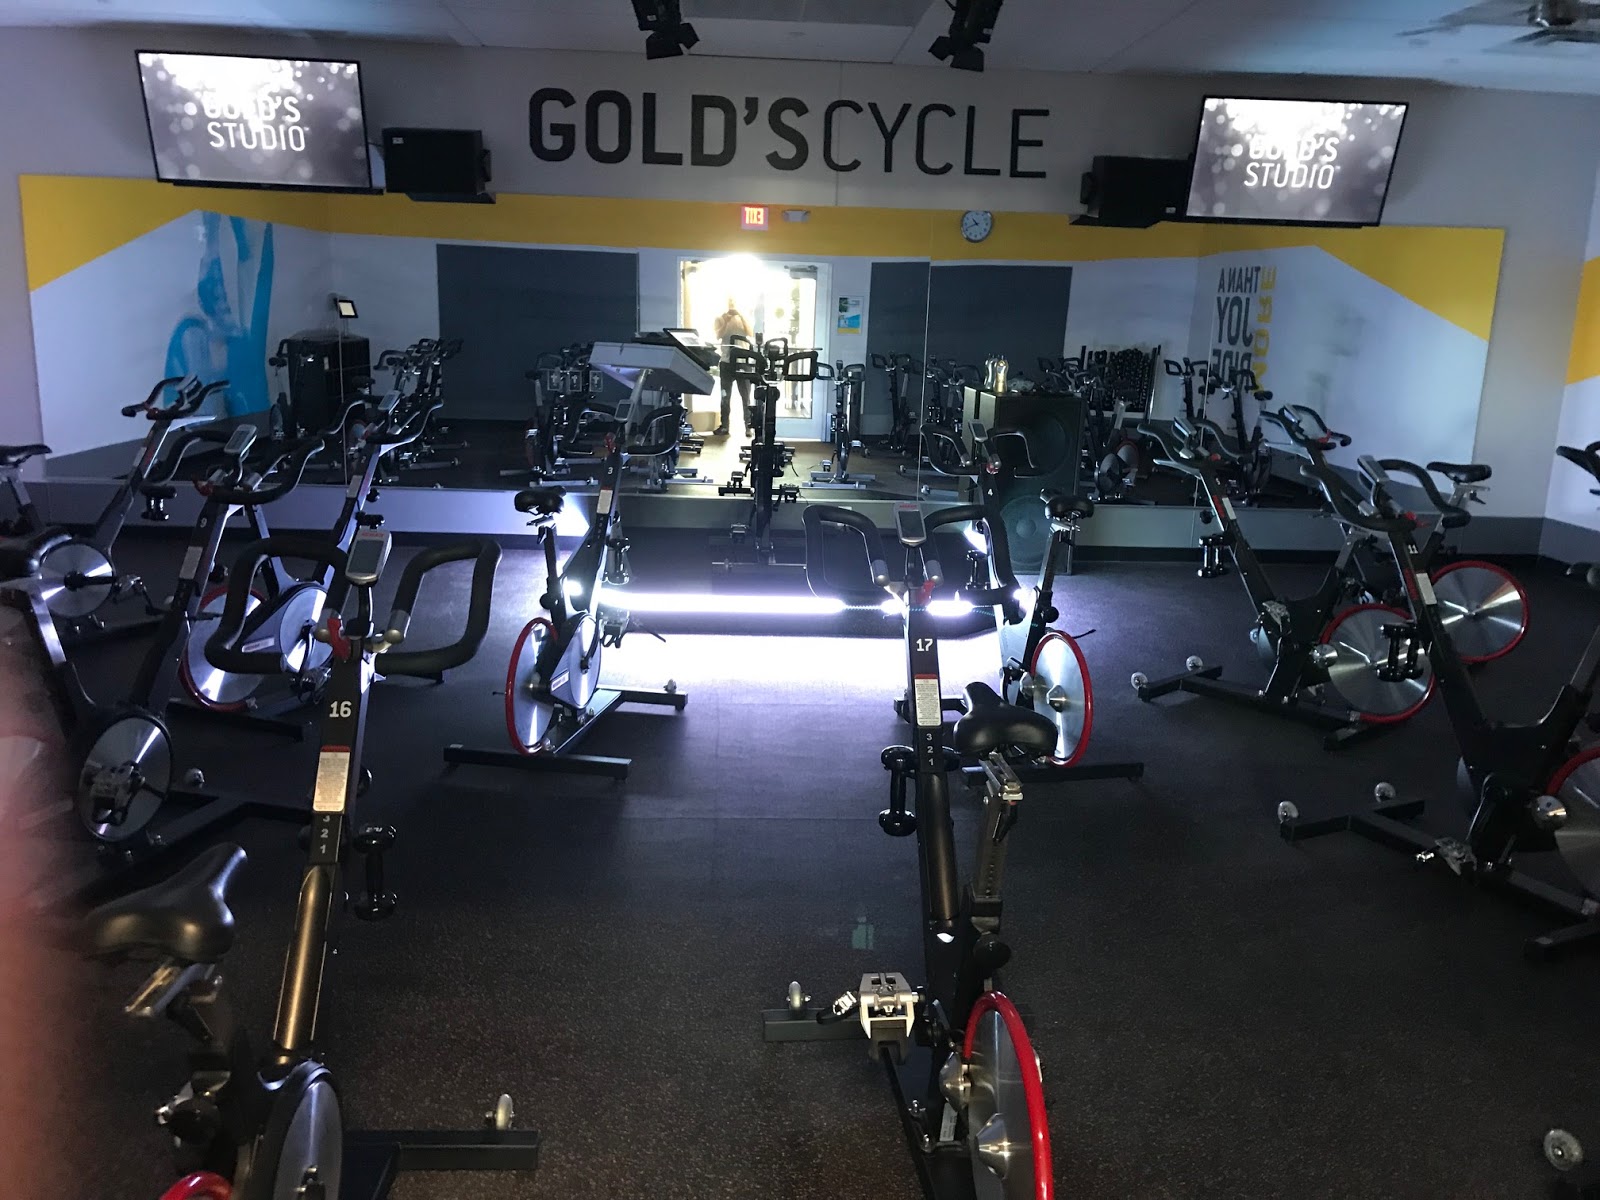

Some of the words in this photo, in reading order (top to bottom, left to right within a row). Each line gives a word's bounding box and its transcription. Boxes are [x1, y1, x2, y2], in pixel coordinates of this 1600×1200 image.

[203, 91, 301, 123] GOD'S
[207, 121, 306, 152] STUDIO
[528, 87, 810, 171] GOLD'S
[823, 99, 1050, 179] CYCLE
[1249, 134, 1340, 162] GOD'S
[1243, 162, 1335, 190] STUDIO
[607, 466, 614, 475] 3
[200, 517, 208, 529] 9
[1407, 544, 1419, 554] 11
[916, 638, 934, 652] 17
[329, 700, 352, 718] 16
[926, 733, 933, 741] 3
[927, 745, 934, 754] 2
[928, 757, 934, 766] 1
[320, 828, 329, 839] 2
[319, 844, 327, 854] 1
